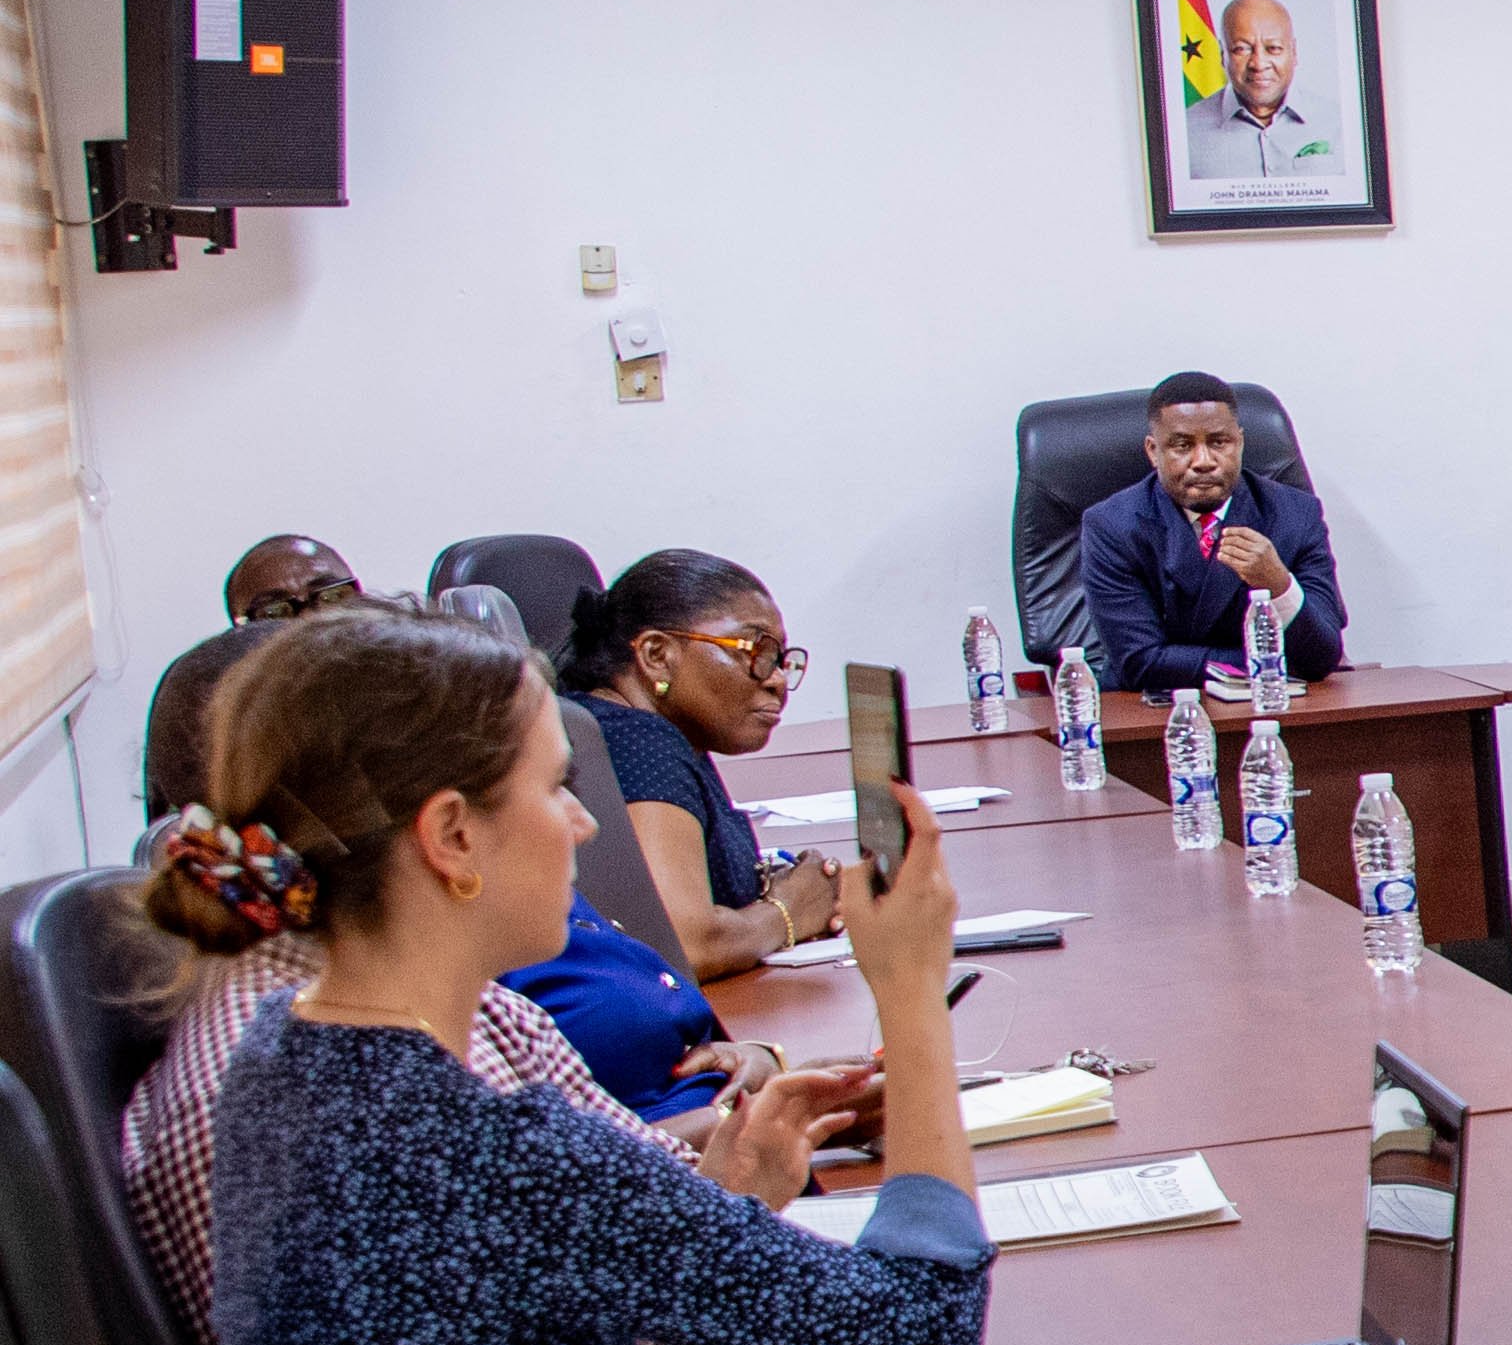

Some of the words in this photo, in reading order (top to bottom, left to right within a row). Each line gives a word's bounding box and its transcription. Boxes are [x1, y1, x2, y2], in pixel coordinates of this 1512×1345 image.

[1209, 191, 1235, 200] JOHN
[1238, 189, 1283, 199] DRAMANI
[1286, 188, 1329, 197] MAHAMA
